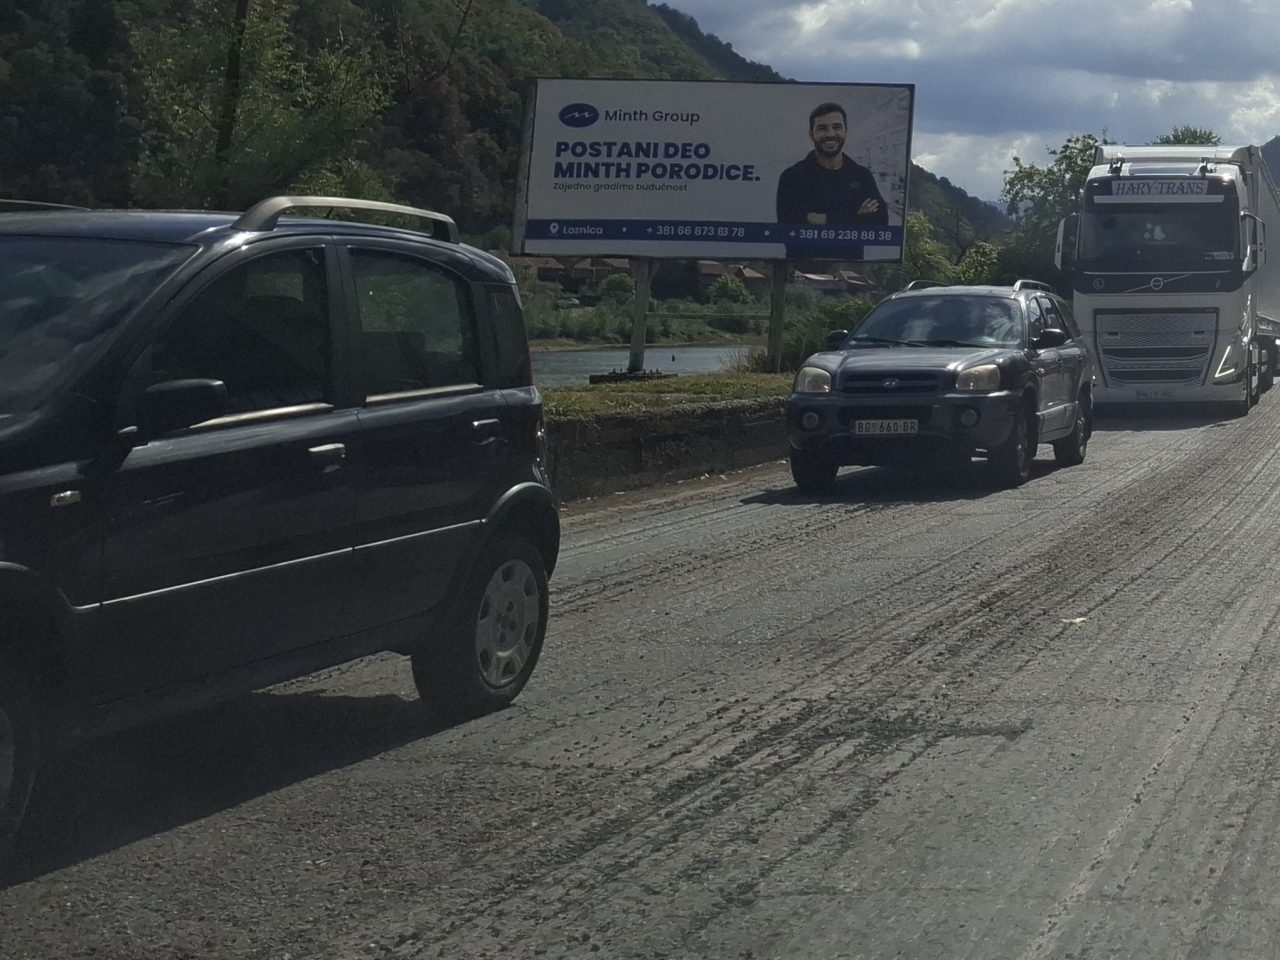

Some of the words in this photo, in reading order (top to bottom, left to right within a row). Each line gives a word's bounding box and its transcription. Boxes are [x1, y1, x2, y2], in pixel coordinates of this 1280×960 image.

[604, 110, 649, 122] Minth
[652, 110, 701, 126] Group
[555, 141, 659, 158] POSTANI
[663, 142, 711, 159] DEO
[553, 162, 632, 179] MINTH
[636, 163, 761, 181] PORODICE.
[552, 182, 592, 192] Zajedno
[594, 183, 633, 193] gradimo
[562, 226, 604, 236] Loznica
[656, 226, 675, 235] 381
[677, 226, 692, 236] 66
[694, 226, 716, 236] 873
[731, 227, 745, 237] 78
[799, 229, 819, 239] 381
[821, 230, 836, 239] 69
[838, 230, 860, 240] 238
[878, 231, 892, 241] 38
